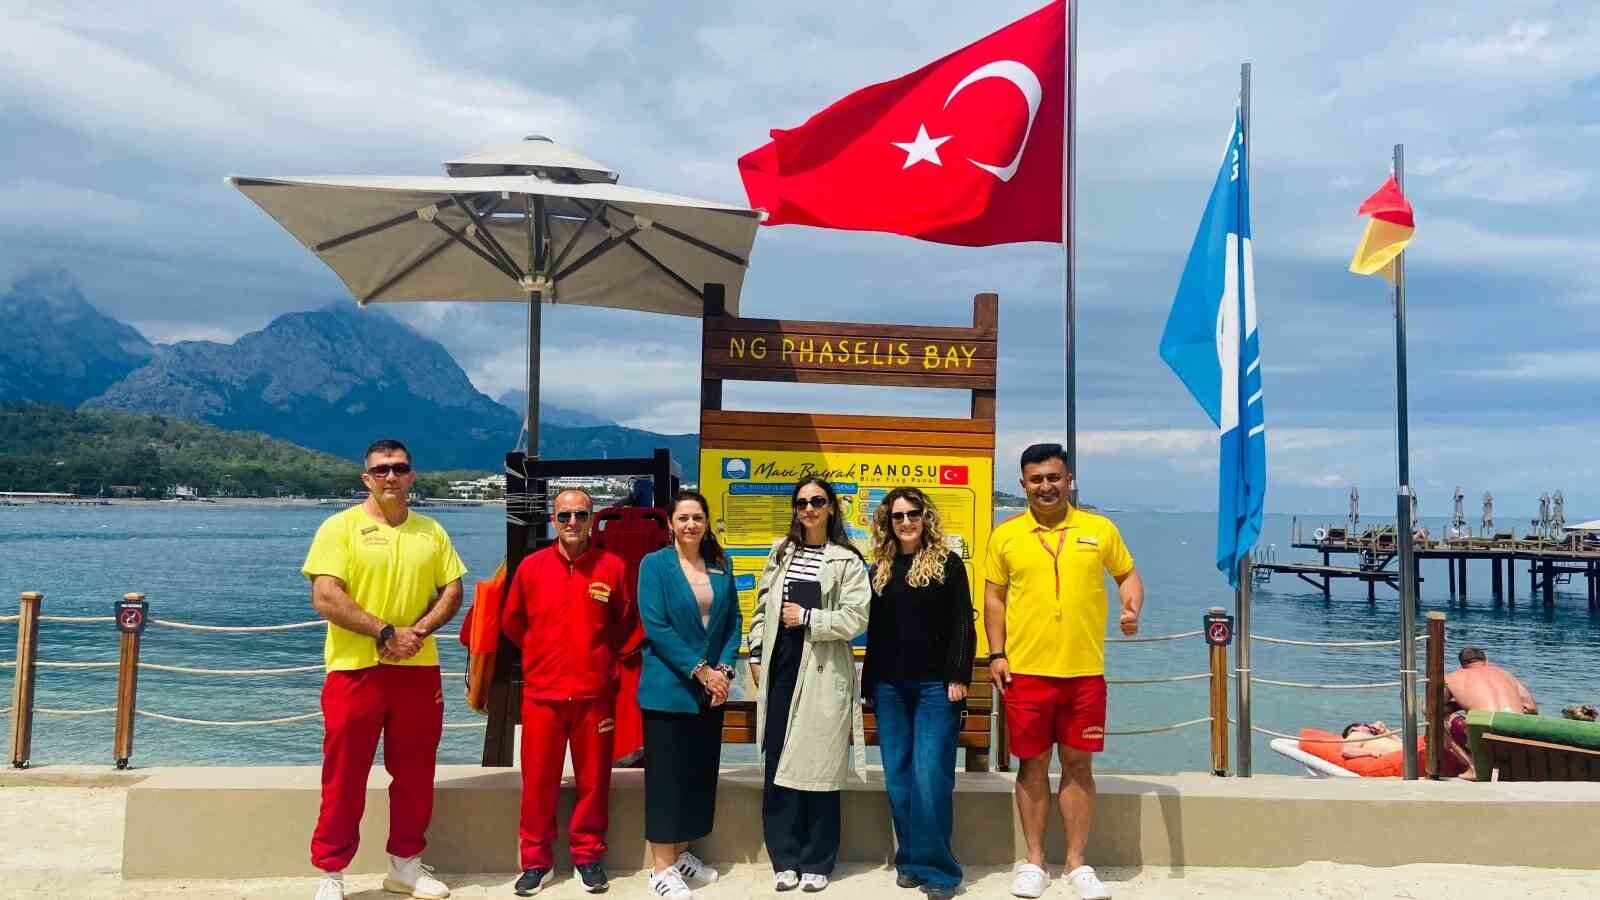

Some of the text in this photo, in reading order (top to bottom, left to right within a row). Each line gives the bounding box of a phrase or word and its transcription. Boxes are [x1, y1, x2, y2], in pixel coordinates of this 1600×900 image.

[729, 337, 977, 369] NG PHASELIS BAY
[754, 461, 937, 480] Mavi Bayrak PANOSU
